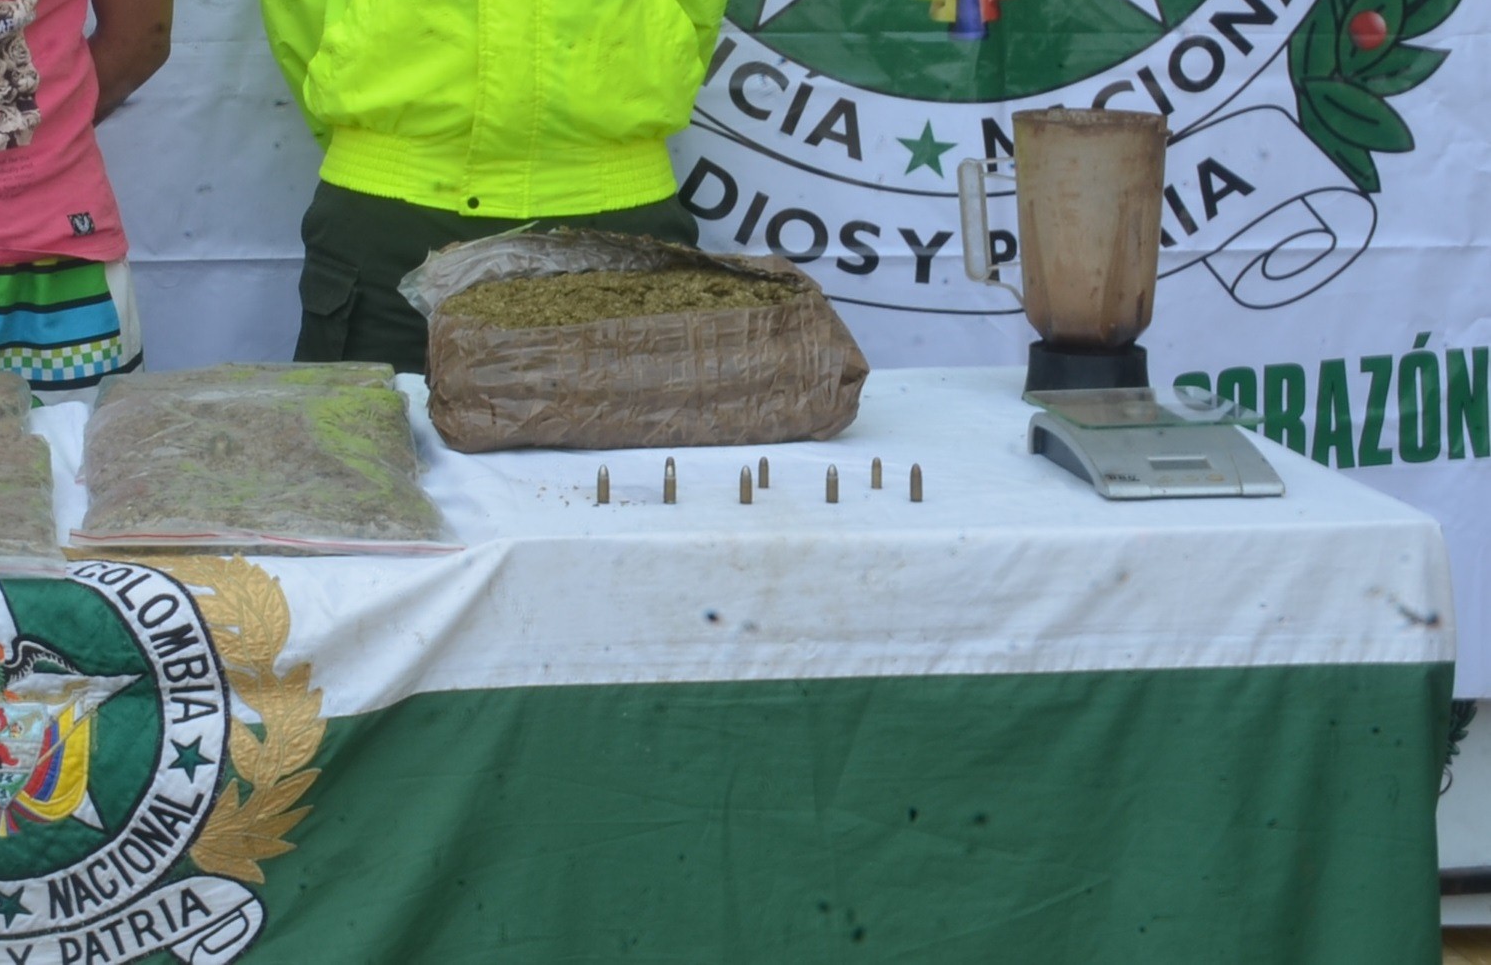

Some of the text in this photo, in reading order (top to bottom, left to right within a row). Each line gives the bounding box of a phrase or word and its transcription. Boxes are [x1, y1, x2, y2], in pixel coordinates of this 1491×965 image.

[677, 156, 881, 276] DIOS
[897, 227, 954, 284] Y
[73, 563, 219, 724] COLOMBIA
[47, 793, 204, 919] NACIONAL
[59, 887, 212, 965] PATRIA
